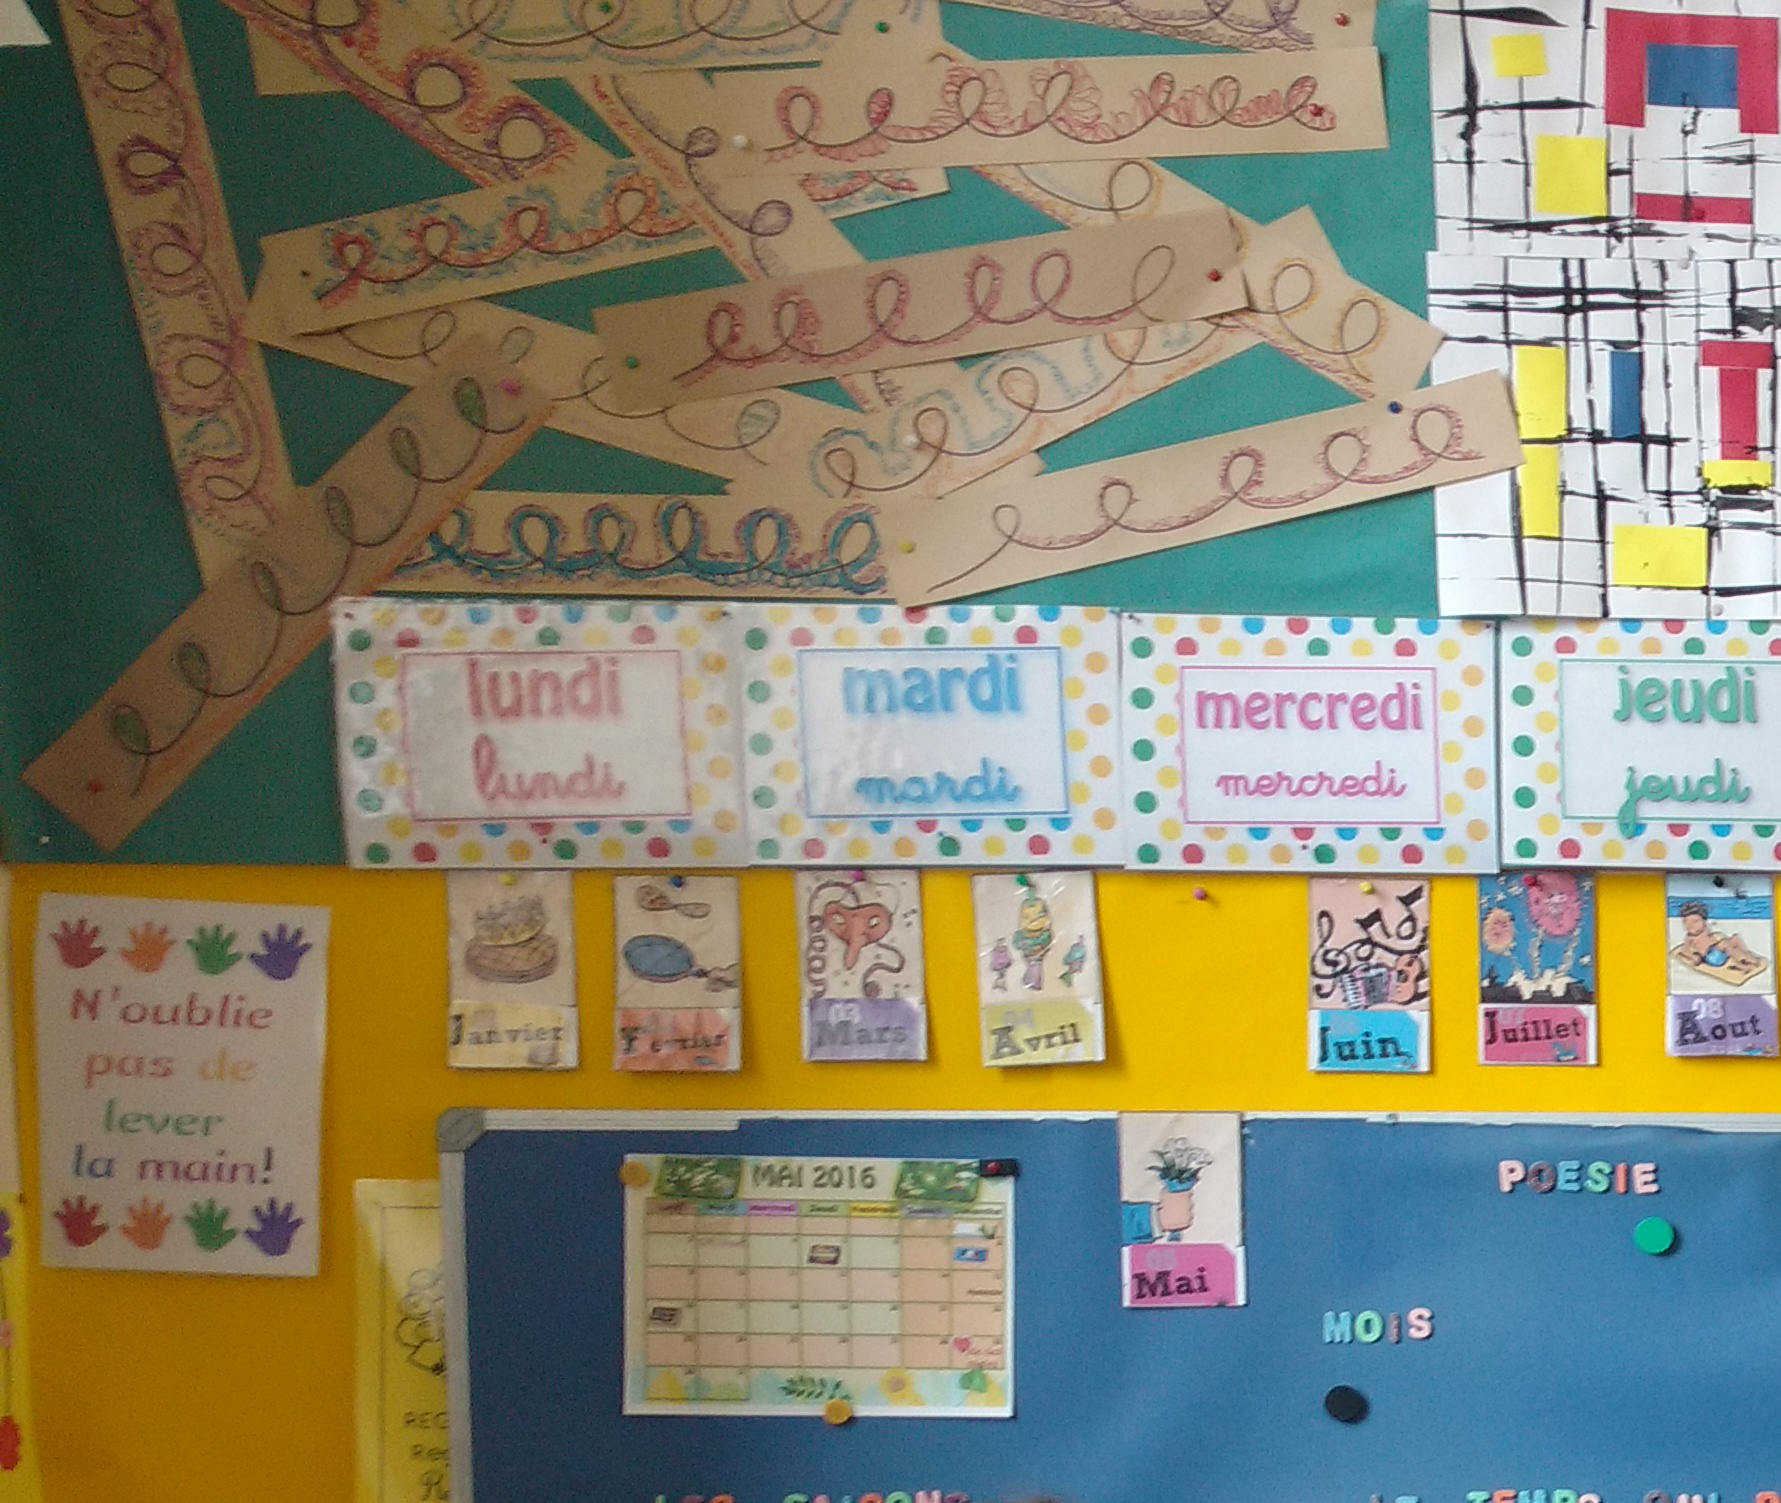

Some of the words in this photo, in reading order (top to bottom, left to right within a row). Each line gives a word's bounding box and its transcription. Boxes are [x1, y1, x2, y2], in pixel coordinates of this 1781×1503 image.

[467, 656, 623, 720] lundi
[844, 652, 1024, 715] mardi
[1613, 665, 1757, 723] jeudi
[1196, 684, 1422, 729] mercredi
[473, 734, 626, 799] lundi
[856, 759, 1021, 802] mardi
[1216, 761, 1407, 797] mercredi
[1617, 759, 1751, 836] jeudi
[69, 987, 273, 1031] N'oublie
[449, 1006, 564, 1049] Janvier
[1483, 1010, 1582, 1045] Juillet
[811, 1021, 907, 1049] Mars
[992, 1023, 1081, 1059] Avril
[1319, 1022, 1402, 1060] Juin
[84, 1051, 174, 1089] pas
[198, 1048, 255, 1083] de
[103, 1098, 224, 1137] lever
[71, 1143, 114, 1181] la
[750, 1164, 803, 1190] MAI
[812, 1164, 876, 1190] 2016
[1500, 1159, 1660, 1196] POESIE
[1132, 1266, 1210, 1299] Mai
[1322, 1307, 1435, 1345] MOIS
